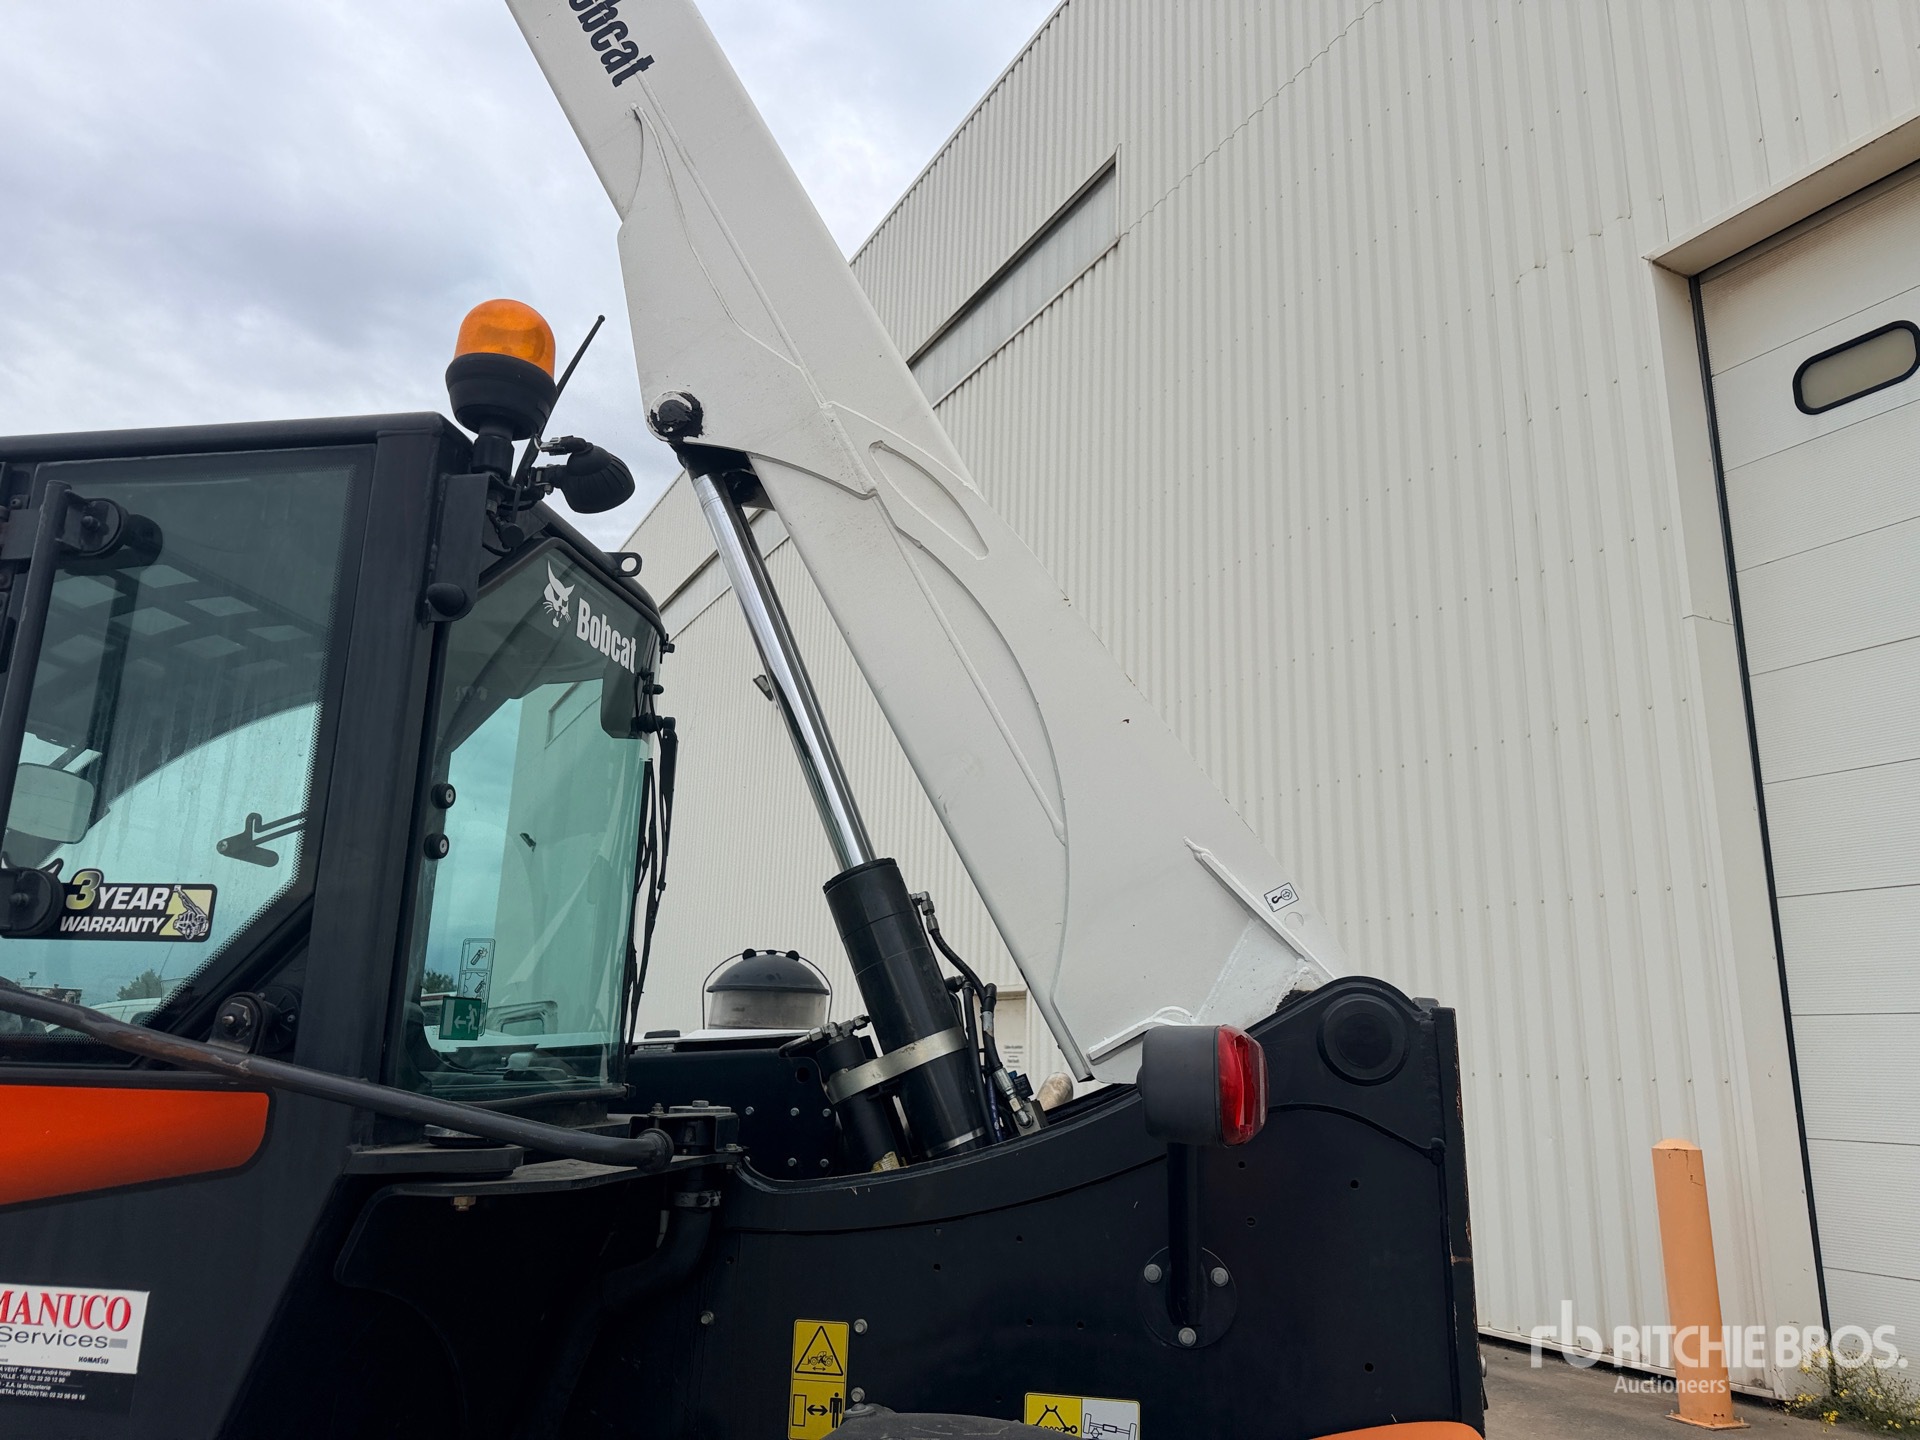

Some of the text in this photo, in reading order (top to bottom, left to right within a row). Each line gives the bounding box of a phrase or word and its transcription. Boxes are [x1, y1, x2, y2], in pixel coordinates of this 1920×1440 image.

[576, 597, 637, 674] Bobcat
[60, 916, 166, 933] WARRANTY
[0, 1326, 108, 1349] Services
[78, 1356, 109, 1365] KOMATSU
